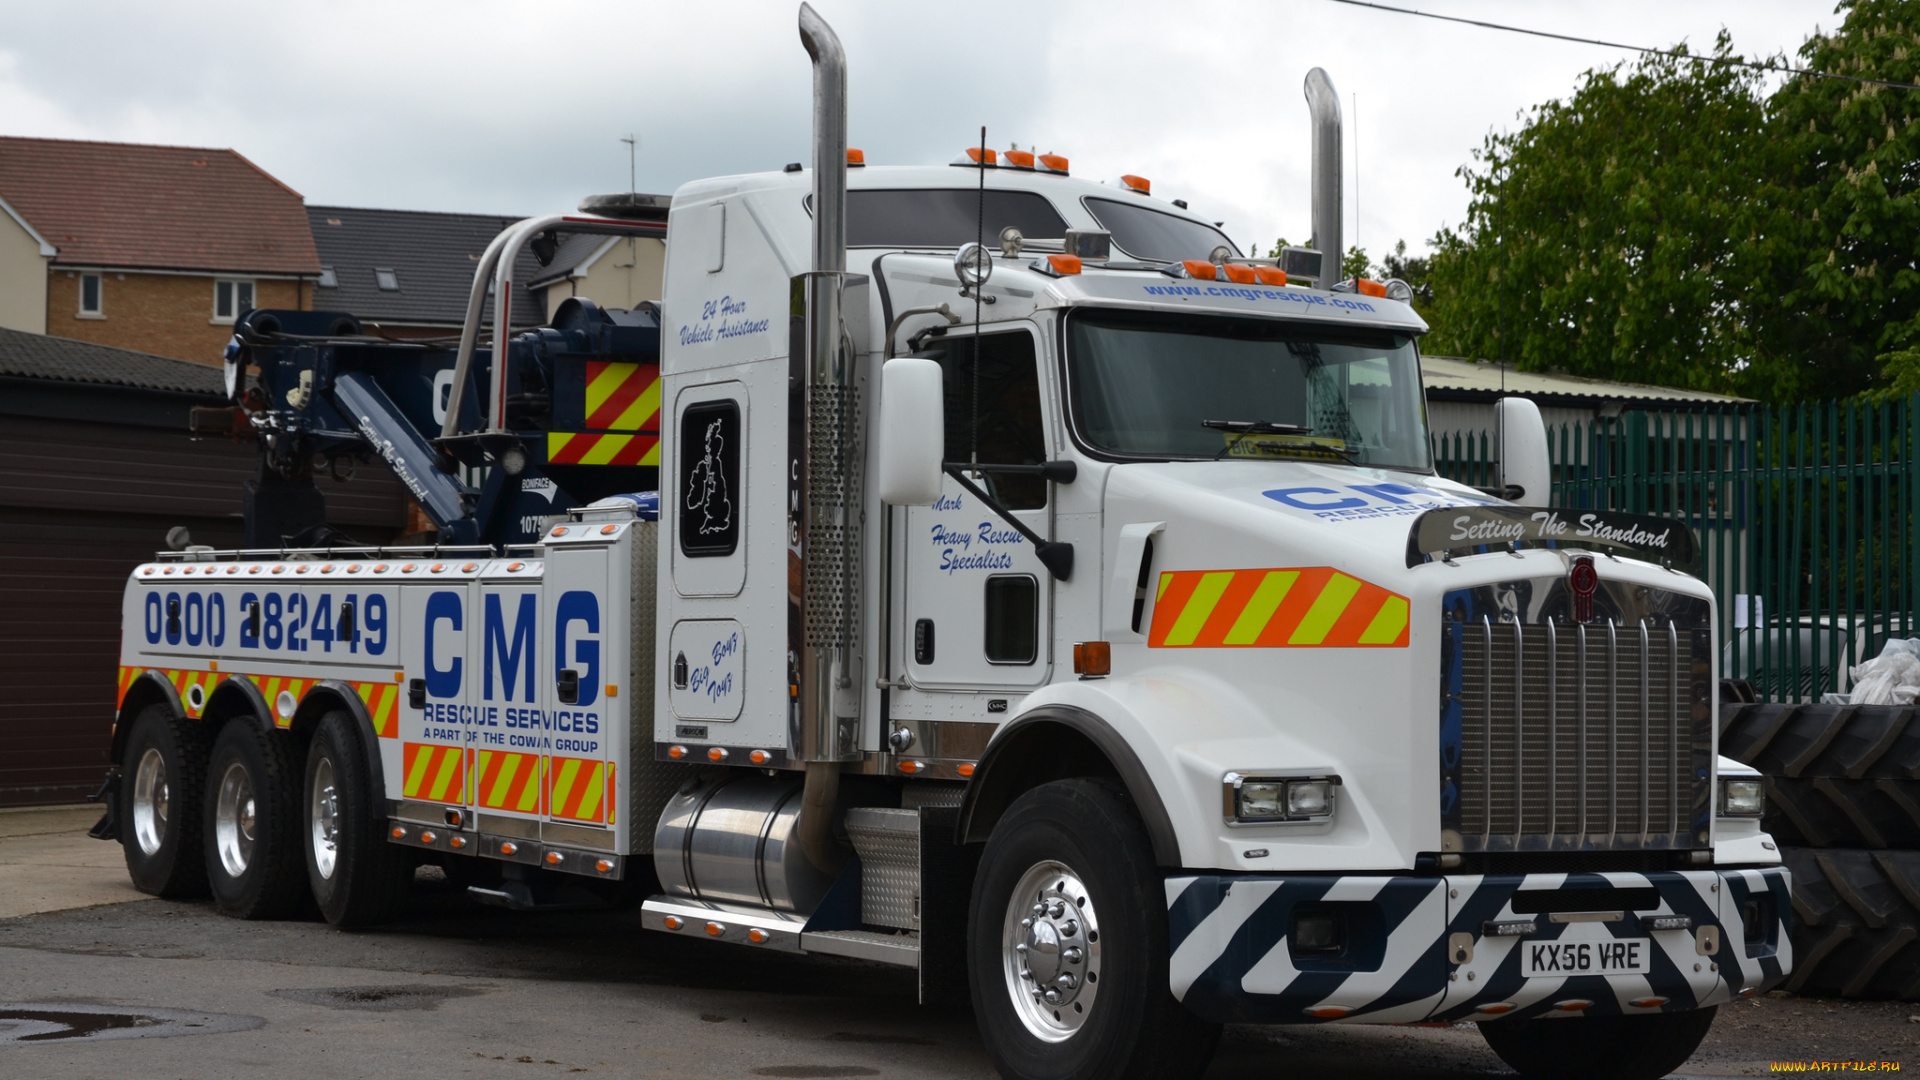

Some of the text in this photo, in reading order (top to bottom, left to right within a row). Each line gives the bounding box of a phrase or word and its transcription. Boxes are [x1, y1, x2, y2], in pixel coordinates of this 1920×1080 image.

[702, 295, 746, 320] 24 Hour
[1144, 285, 1376, 313] www.cmgrescue.com
[680, 318, 769, 346] Vehicle Assistance
[392, 457, 429, 502] Standard
[521, 477, 550, 489] BONIFACE
[930, 521, 1025, 551] Heavy Rescue
[1450, 511, 1670, 549] Setting The Standard
[939, 548, 1013, 576] Specialists
[145, 591, 388, 656] 0800 282449
[423, 702, 599, 735] RESCUE SERVICES
[423, 727, 598, 753] A PART OF THE COWAN GROUP
[1532, 943, 1640, 971] KX56 VRE
